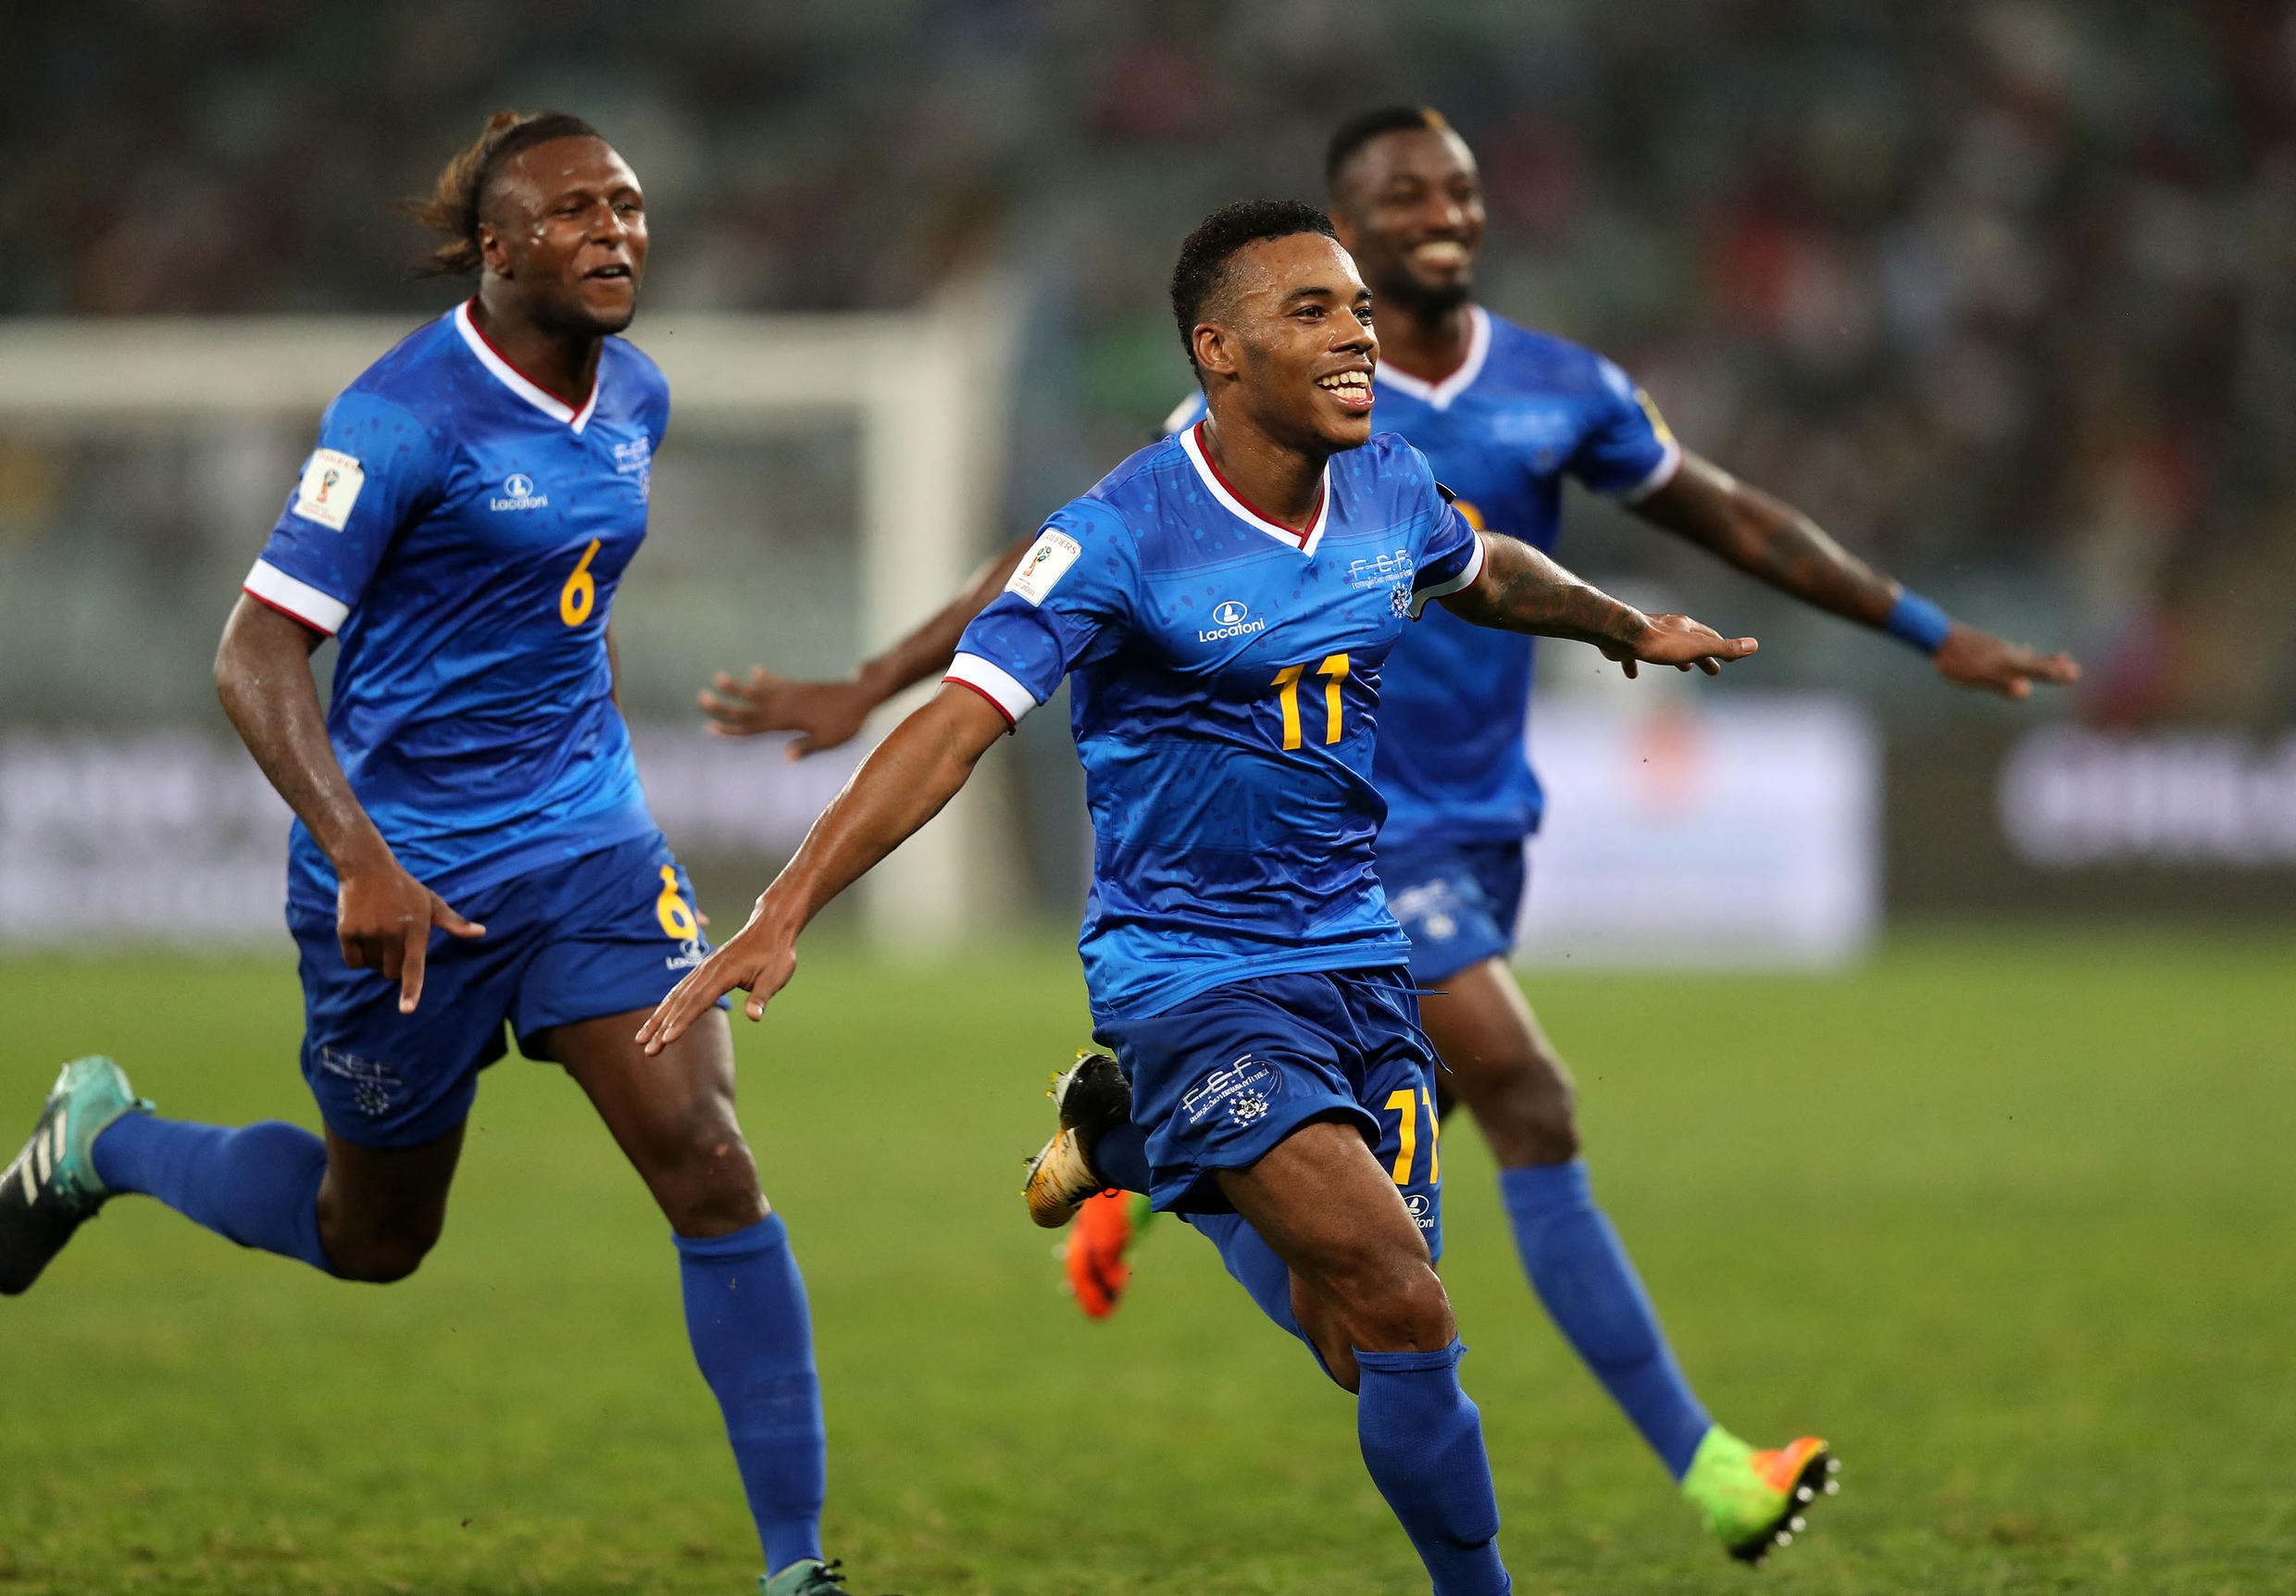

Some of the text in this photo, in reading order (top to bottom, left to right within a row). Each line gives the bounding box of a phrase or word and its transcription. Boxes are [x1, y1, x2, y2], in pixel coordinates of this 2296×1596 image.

[559, 538, 602, 627] 6
[1198, 617, 1266, 643] Lacatoni
[1269, 653, 1350, 752] 11
[656, 864, 698, 940] 6
[1383, 1087, 1440, 1185] 11
[1415, 1216, 1435, 1228] toni
